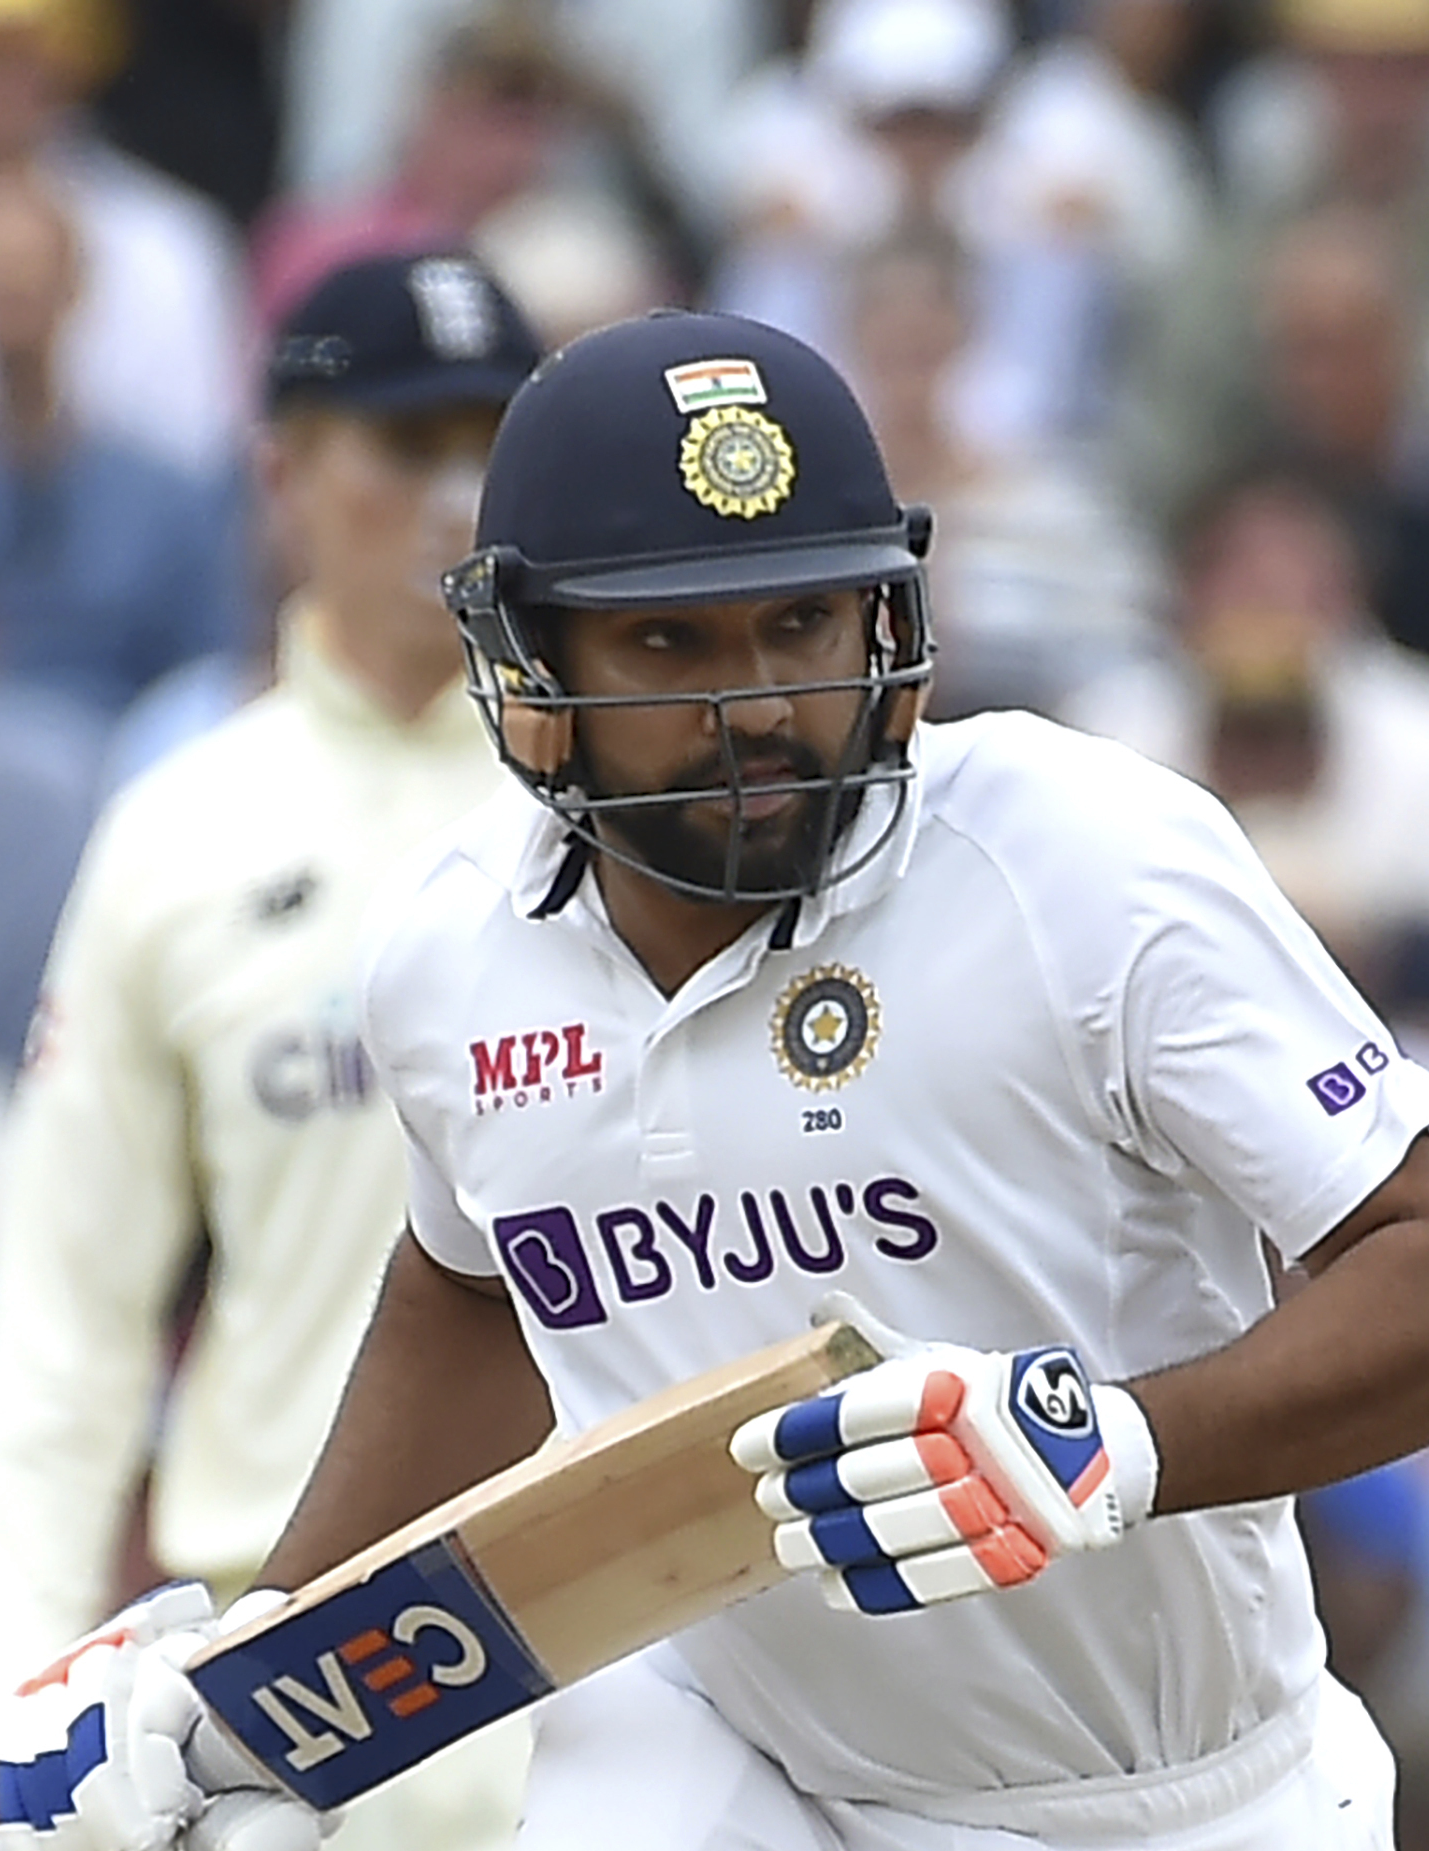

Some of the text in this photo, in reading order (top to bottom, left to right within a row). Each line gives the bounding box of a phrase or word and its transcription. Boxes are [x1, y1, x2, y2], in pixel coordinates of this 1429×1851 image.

[469, 1022, 602, 1096] MPL
[475, 1077, 602, 1117] SPORTS
[801, 1107, 843, 1133] 280
[595, 1177, 939, 1304] BYJU'S
[251, 1605, 486, 1772] CEAT
